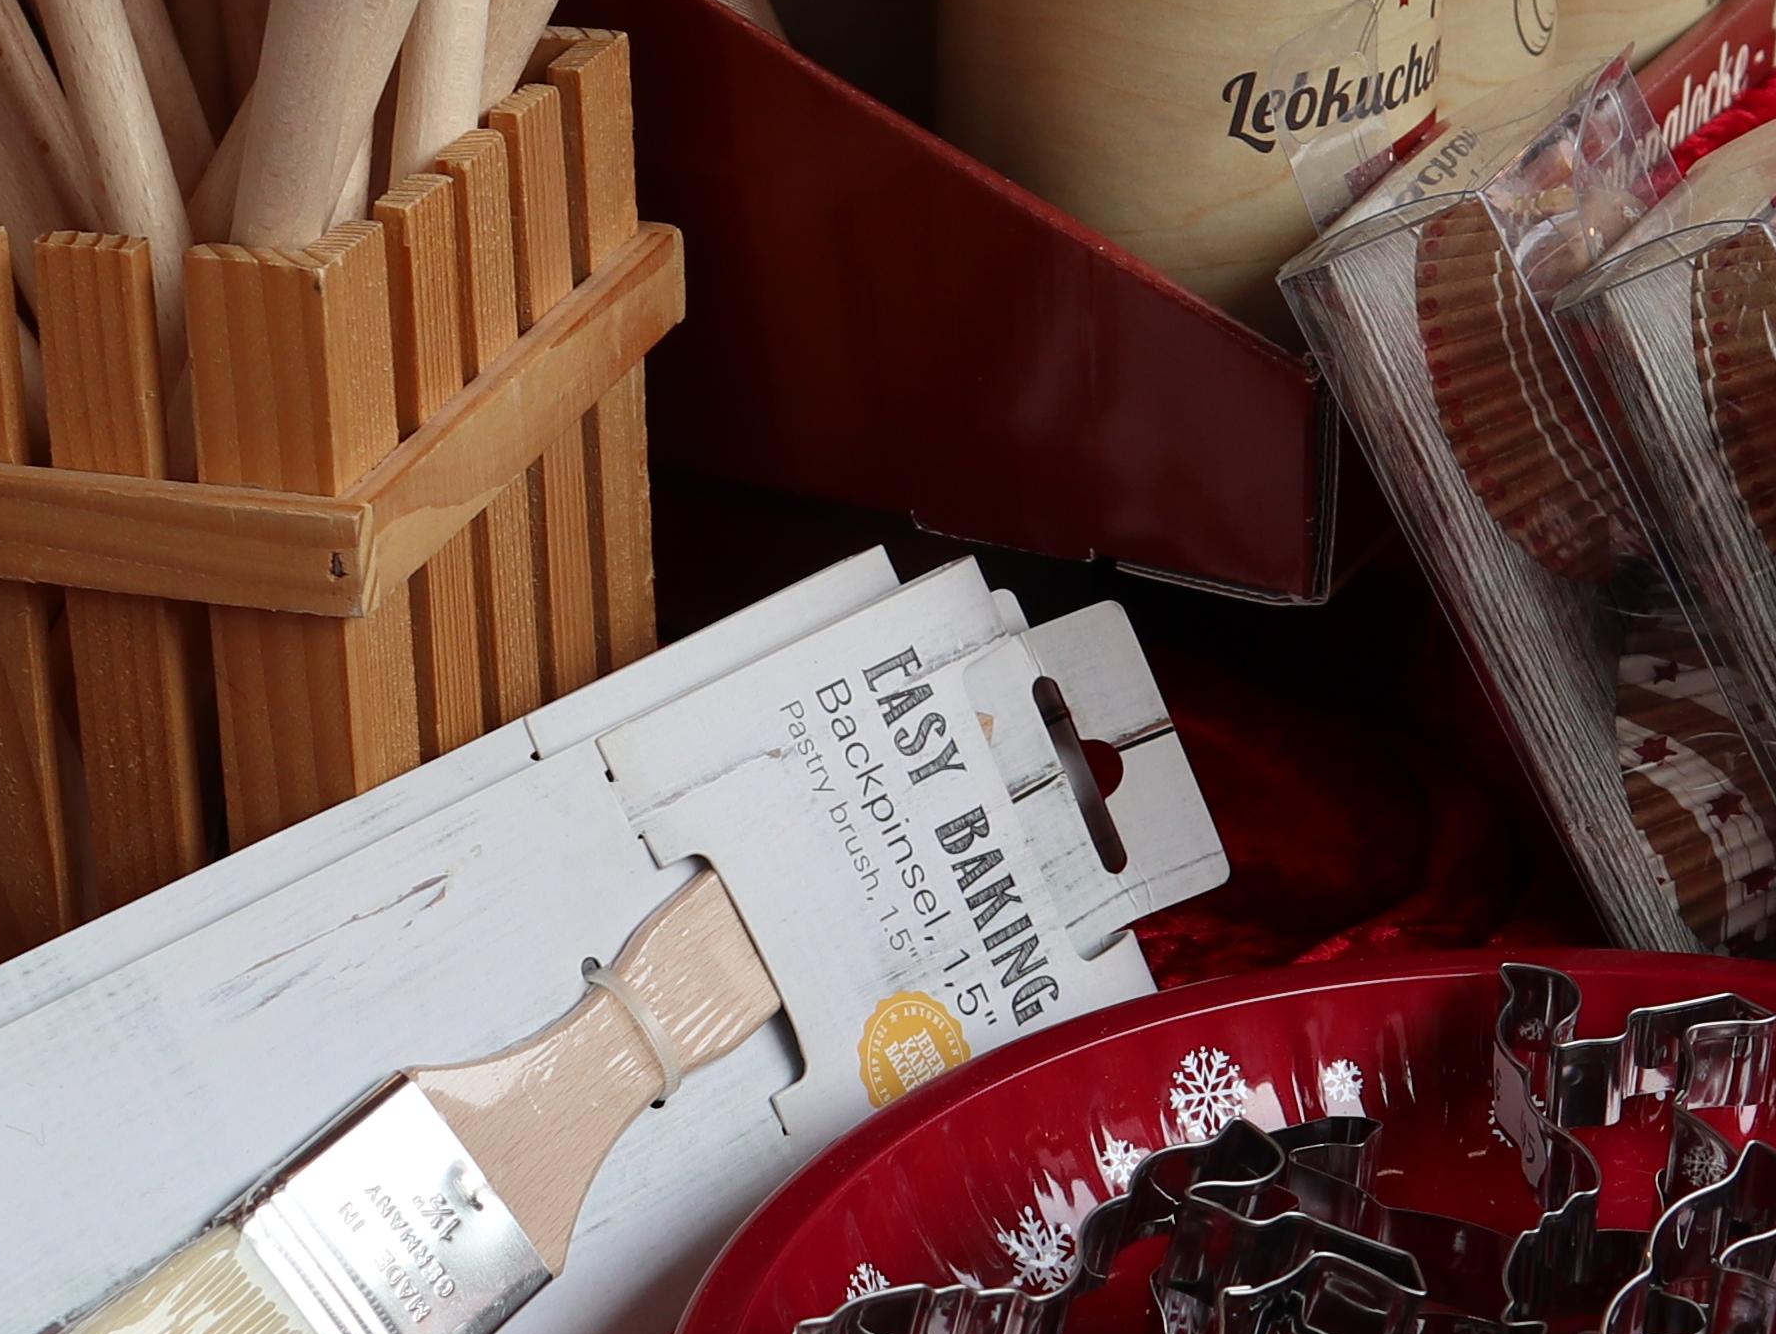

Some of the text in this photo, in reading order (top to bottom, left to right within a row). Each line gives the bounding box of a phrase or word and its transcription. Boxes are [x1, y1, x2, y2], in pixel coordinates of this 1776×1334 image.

[779, 699, 836, 796] Pastry
[828, 802, 880, 902] brush,
[815, 677, 952, 942] Backpinsel,
[862, 643, 1061, 1027] EASY BAKING
[364, 1184, 456, 1299] GERMANY
[376, 1250, 432, 1323] MADE
